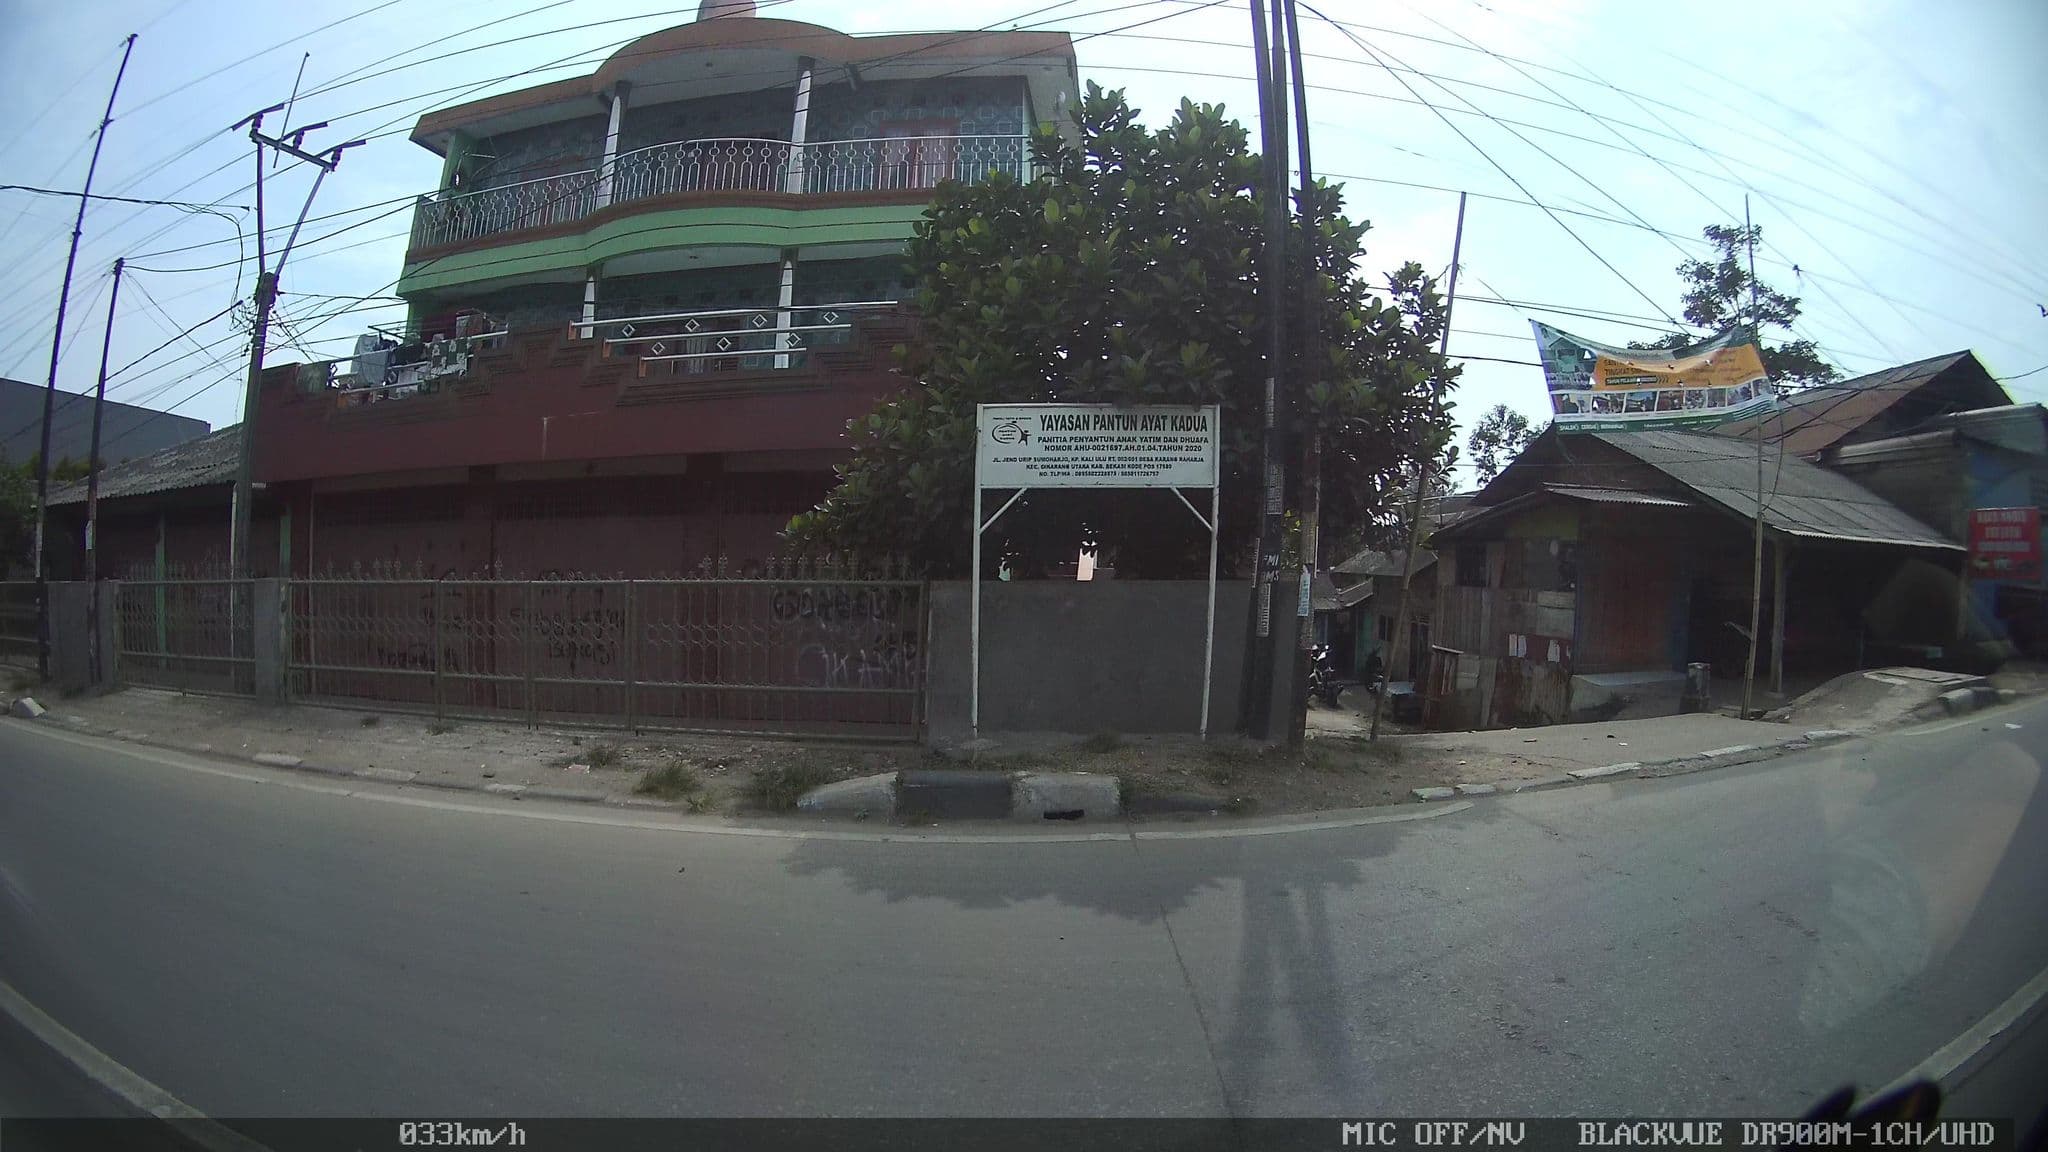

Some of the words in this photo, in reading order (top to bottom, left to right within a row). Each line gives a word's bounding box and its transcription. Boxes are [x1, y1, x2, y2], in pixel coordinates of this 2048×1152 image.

[1040, 414, 1090, 431] YAYASAN
[1093, 414, 1137, 431] PANTUN
[1141, 415, 1167, 432] AYAT
[1170, 415, 1208, 432] KADUA
[1180, 436, 1209, 444] DHUAFA
